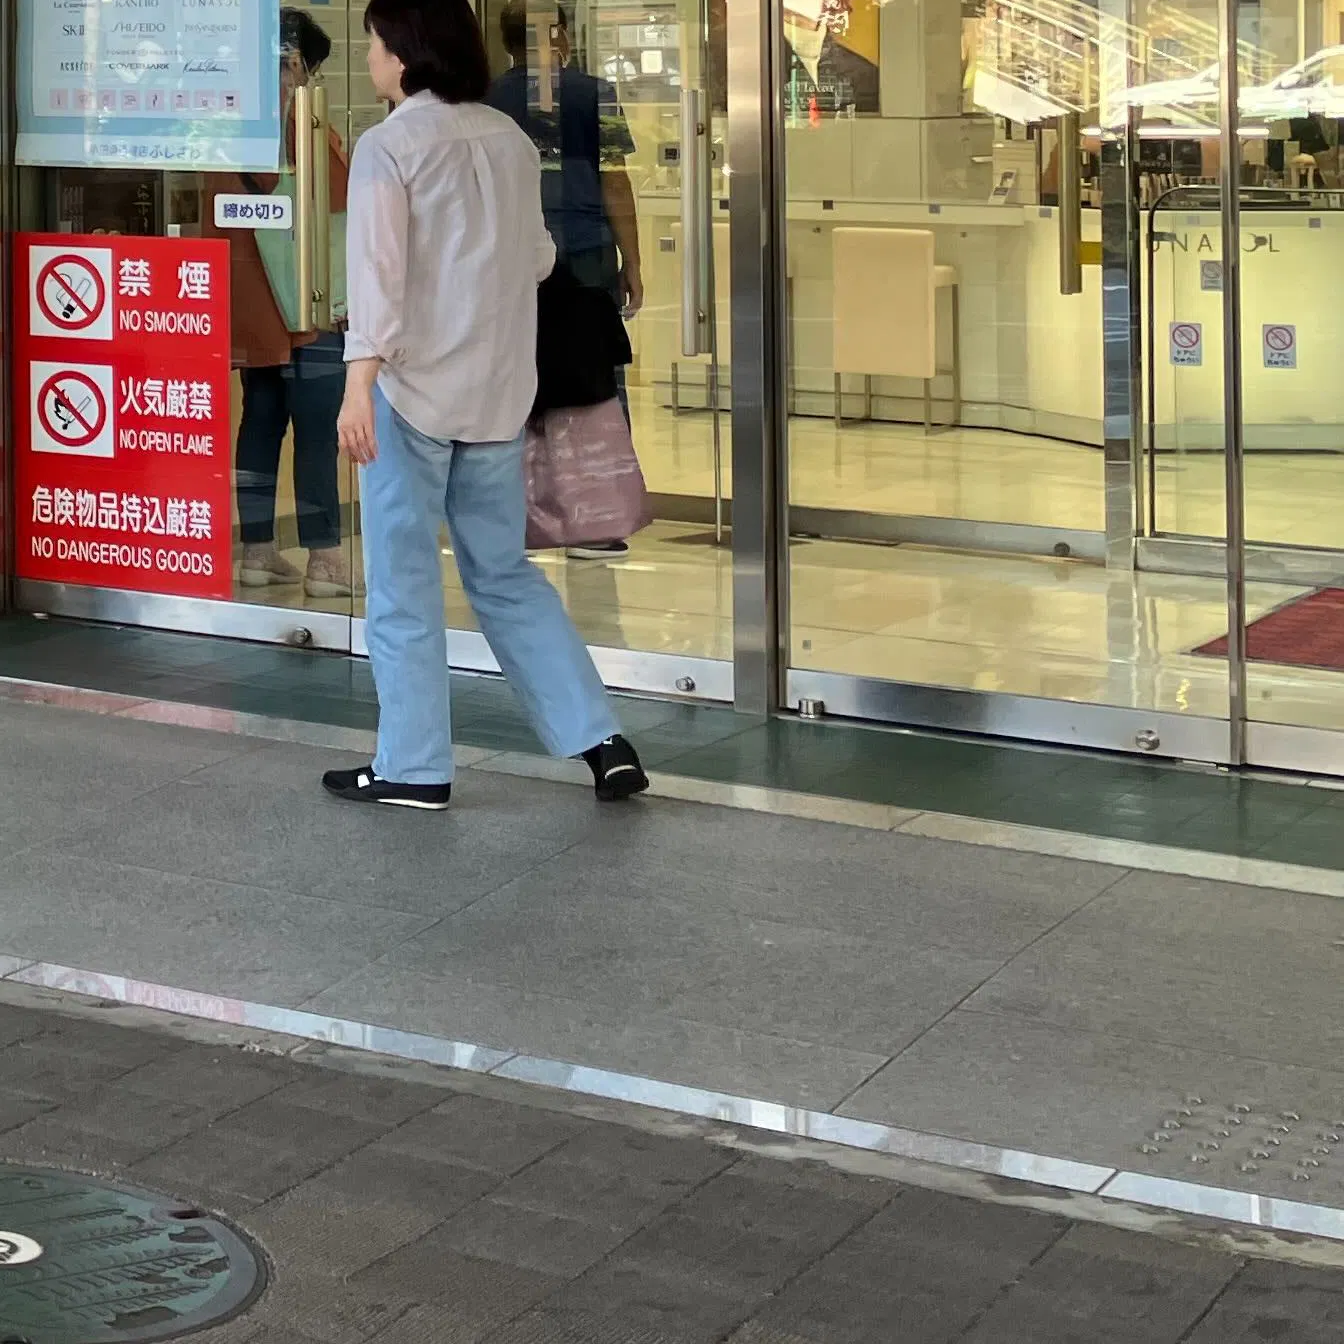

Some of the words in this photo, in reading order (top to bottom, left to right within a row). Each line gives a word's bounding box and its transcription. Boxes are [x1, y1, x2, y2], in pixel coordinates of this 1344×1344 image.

[112, 23, 166, 33] SHISEIDO
[223, 202, 285, 220] 締め切り
[119, 258, 211, 300] 禁煙
[119, 310, 141, 332] NO
[144, 312, 211, 336] SMOKING
[120, 376, 212, 421] 火気厳禁
[119, 429, 137, 448] NO
[139, 430, 172, 453] OPEN
[173, 433, 213, 456] FLAME
[32, 484, 212, 541] 危険物品持込厳禁
[32, 536, 53, 559] NO
[57, 539, 152, 569] DANGEROUS
[156, 548, 213, 576] GOODS
